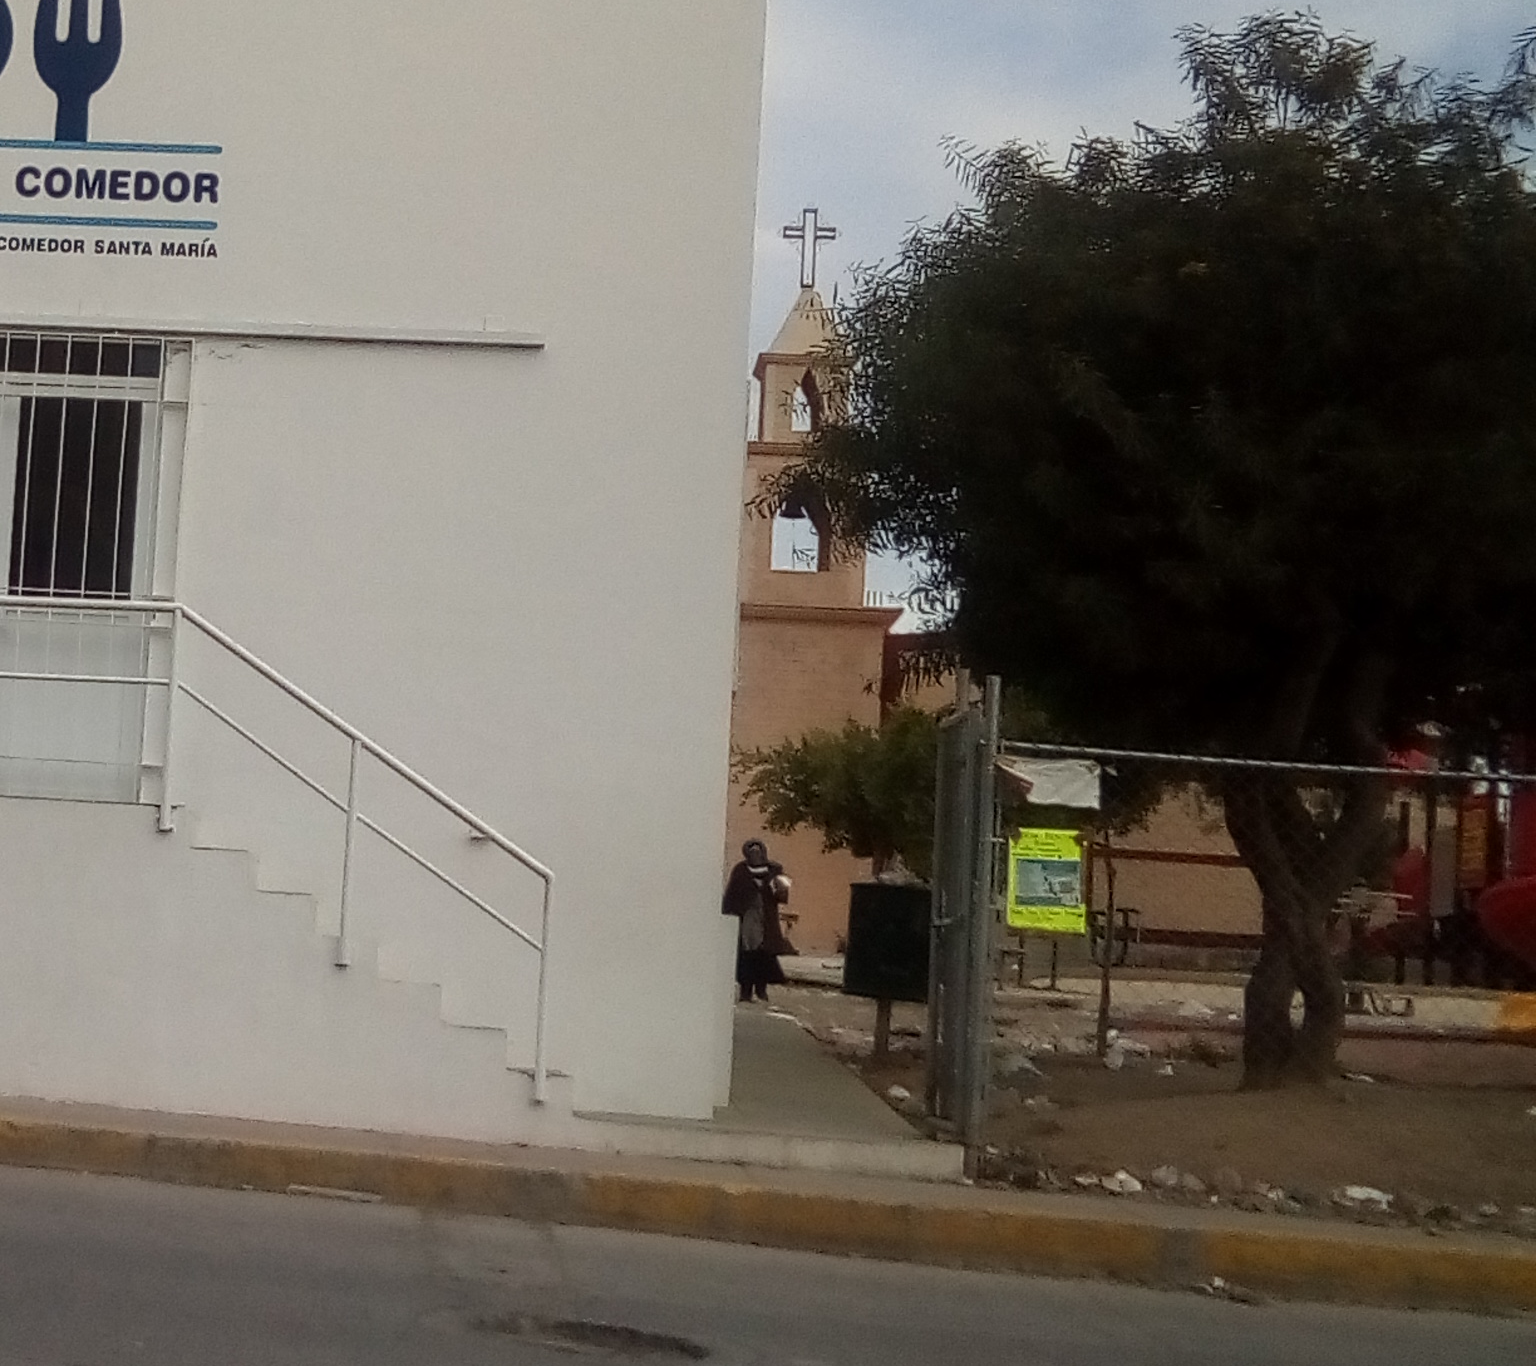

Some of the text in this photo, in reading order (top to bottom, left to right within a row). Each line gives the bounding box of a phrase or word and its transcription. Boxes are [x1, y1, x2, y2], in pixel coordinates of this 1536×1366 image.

[15, 165, 220, 204] COMEDOR
[94, 239, 153, 257] SANTA
[160, 237, 218, 259] MARÍA
